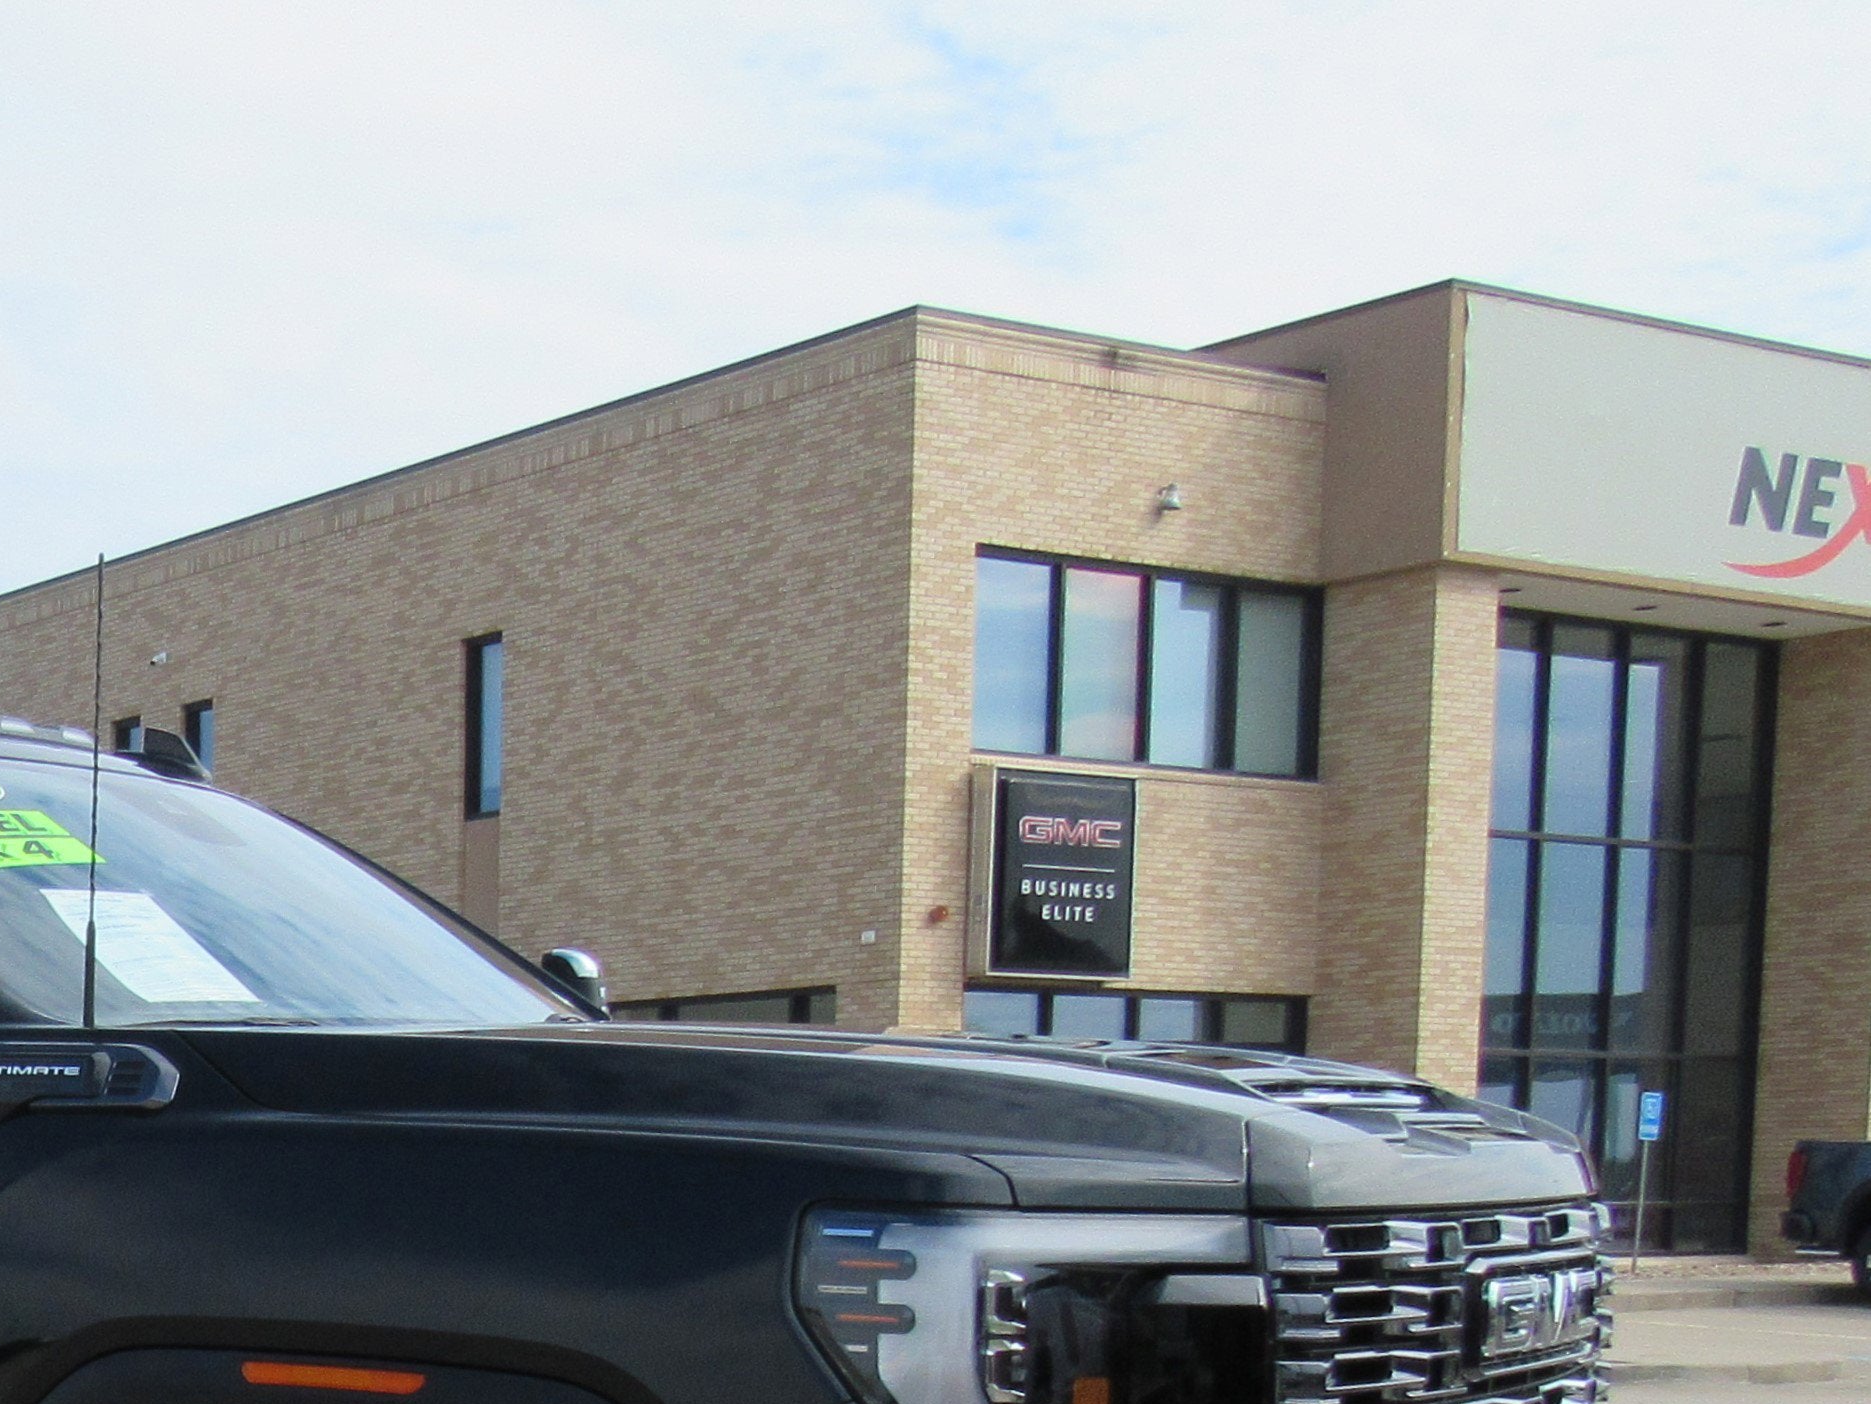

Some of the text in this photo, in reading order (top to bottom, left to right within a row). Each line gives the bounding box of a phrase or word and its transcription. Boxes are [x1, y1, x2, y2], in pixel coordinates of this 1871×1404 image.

[1019, 815, 1122, 848] GMC
[1020, 879, 1116, 900] BUSINESS
[1041, 904, 1095, 922] ELITE
